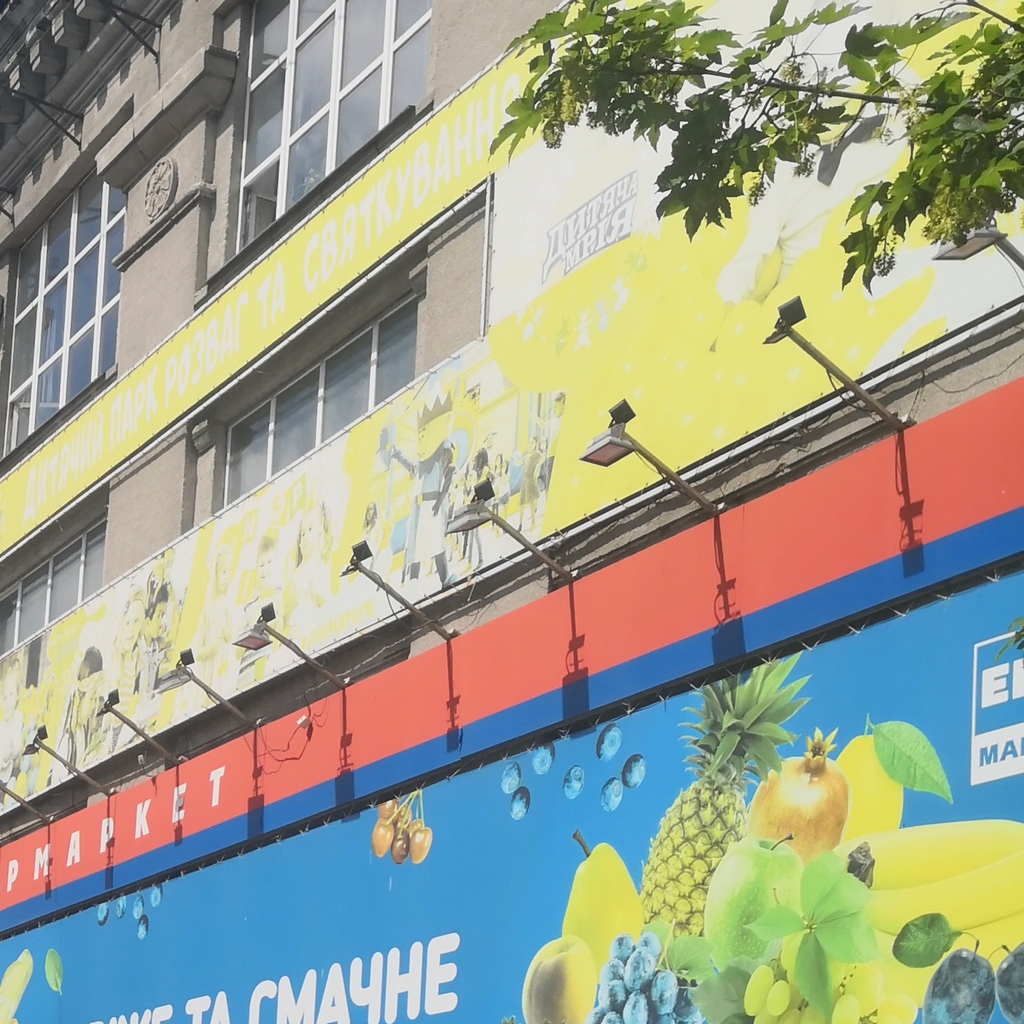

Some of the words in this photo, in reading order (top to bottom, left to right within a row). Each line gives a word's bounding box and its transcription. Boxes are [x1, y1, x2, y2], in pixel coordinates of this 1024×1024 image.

[541, 169, 638, 286] ДИТЯЧА
[564, 197, 637, 275] МРІЯ
[22, 409, 105, 528] ДИТЯЧИЙ
[109, 364, 158, 452] ПАРК
[164, 291, 249, 409] РОЗВАГ
[256, 260, 287, 332] ТА
[980, 659, 1024, 709] Е
[979, 736, 1024, 768] МА
